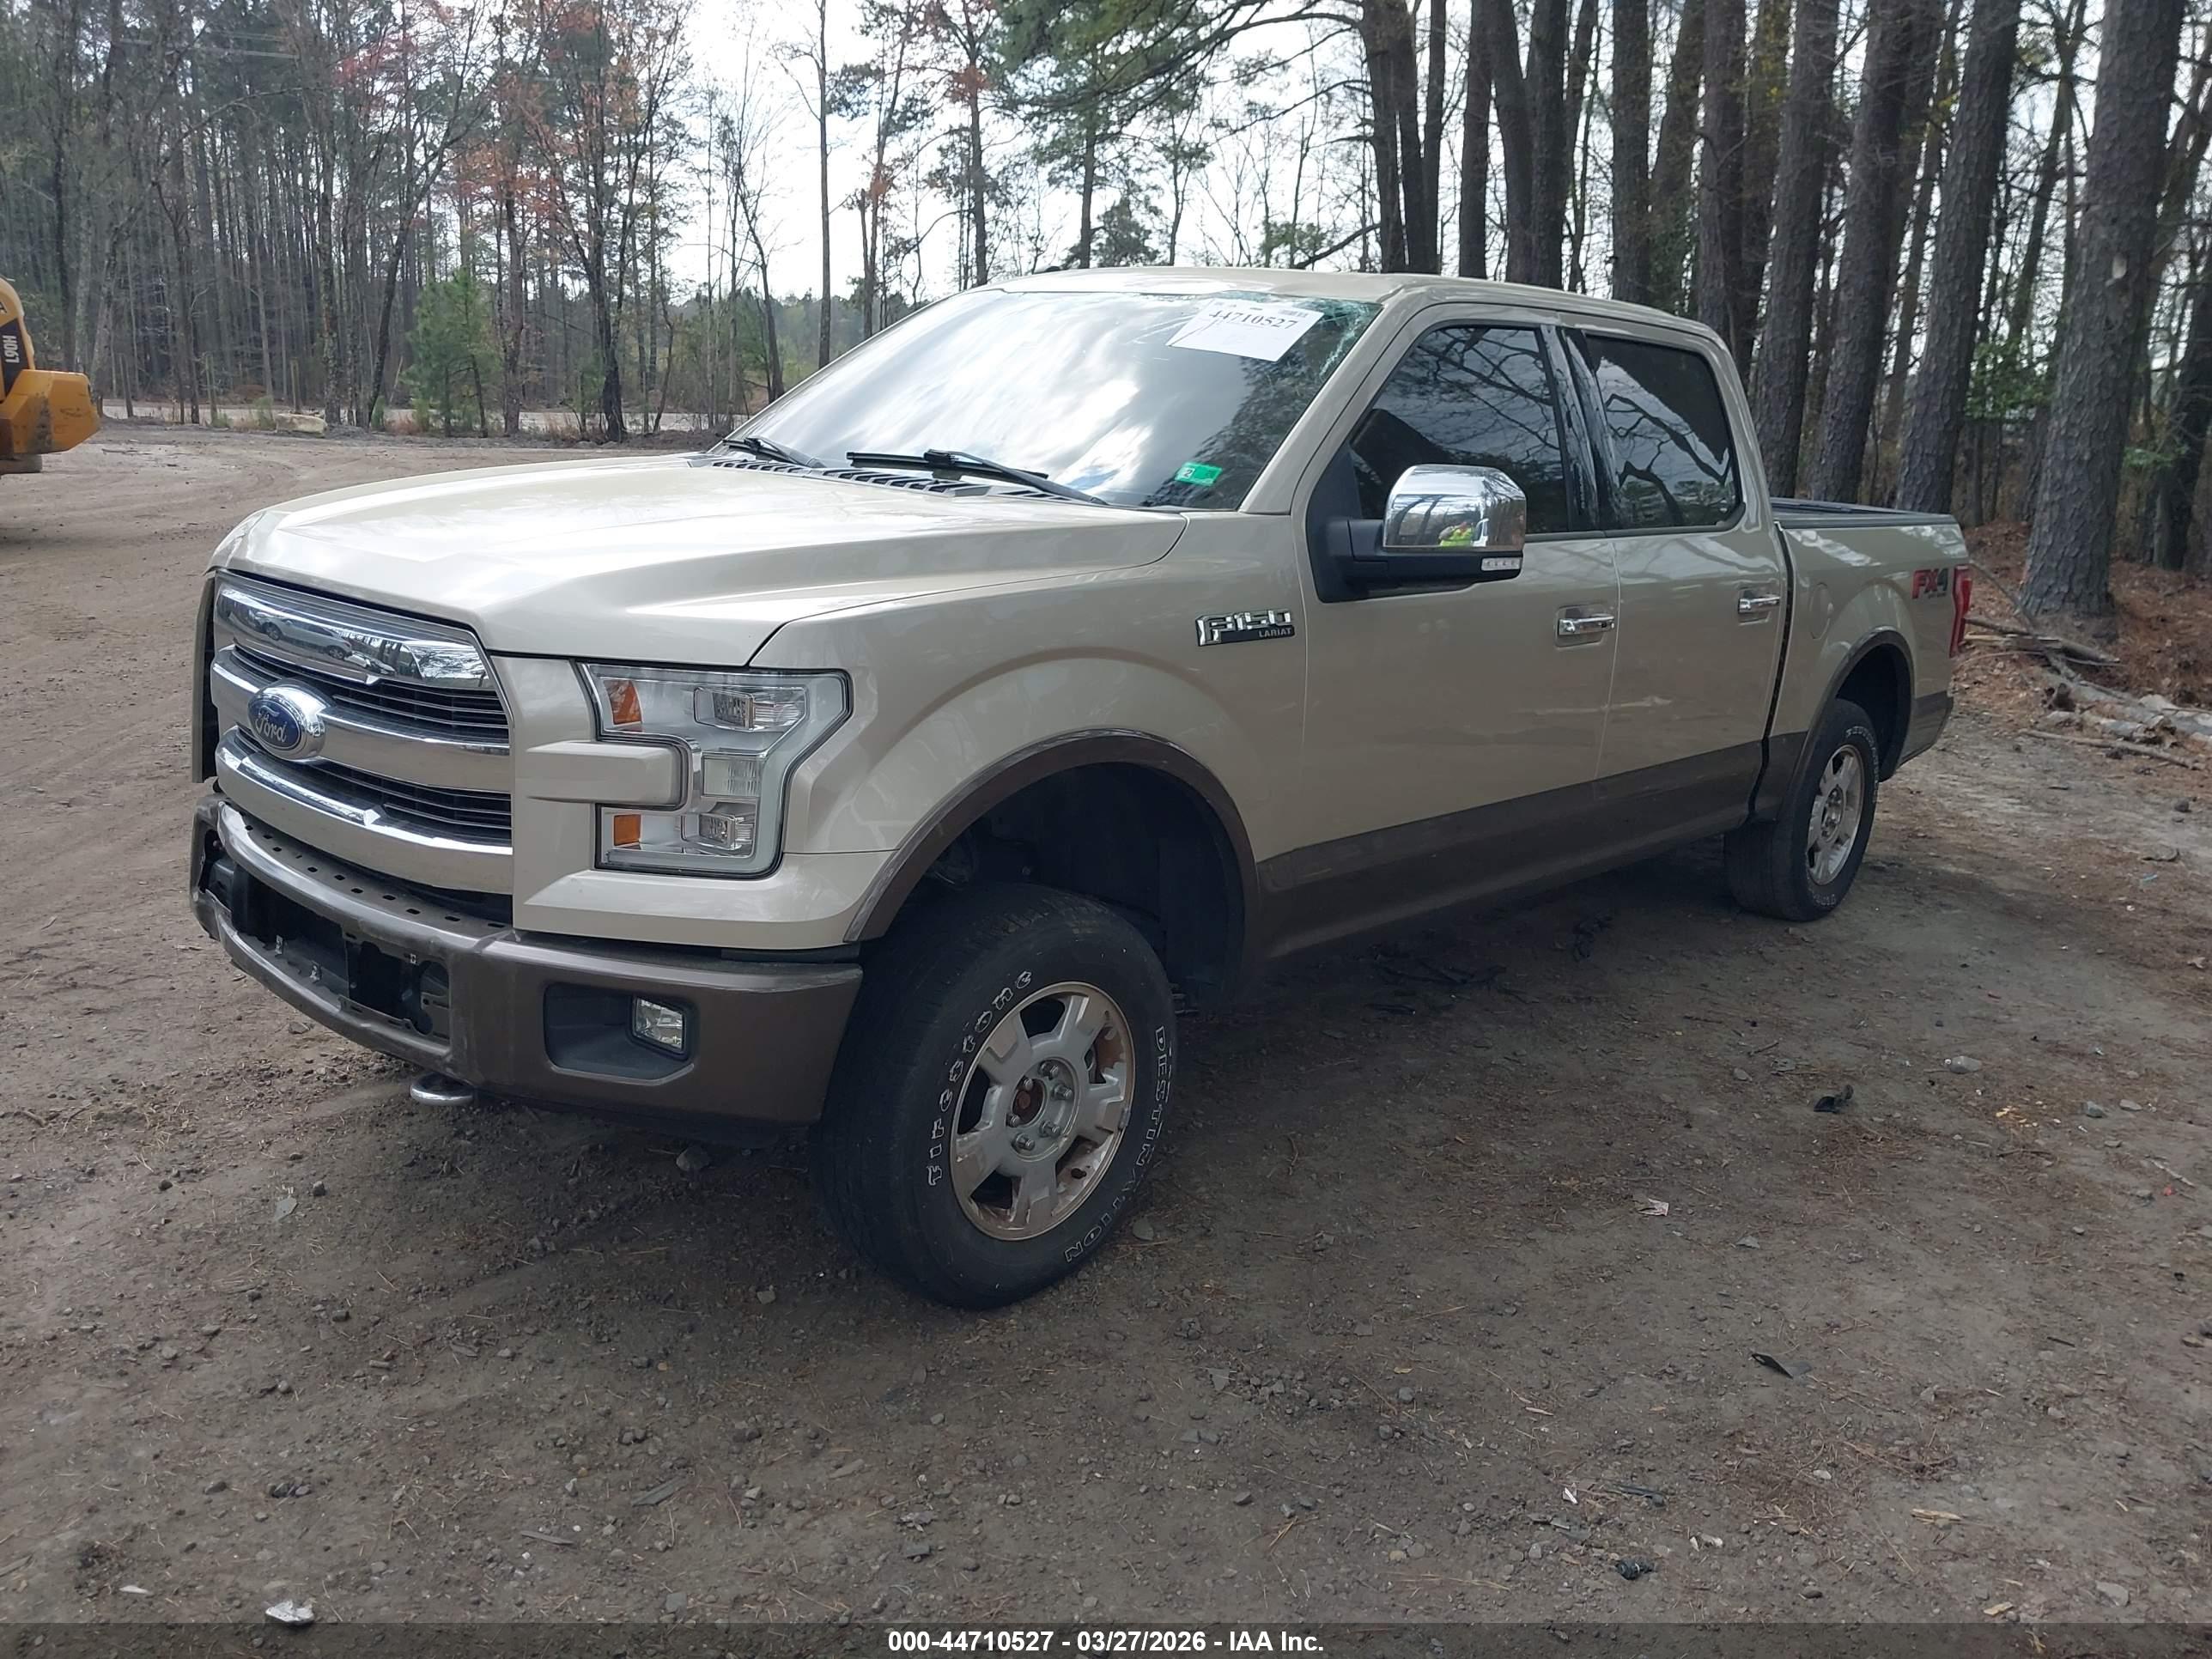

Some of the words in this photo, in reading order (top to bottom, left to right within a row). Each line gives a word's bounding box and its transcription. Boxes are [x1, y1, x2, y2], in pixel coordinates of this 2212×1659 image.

[1209, 310, 1298, 329] 44710527
[3, 335, 20, 363] L90H
[1911, 568, 1949, 599] FX4
[1258, 627, 1292, 638] LARIAT
[255, 705, 288, 743] Ford
